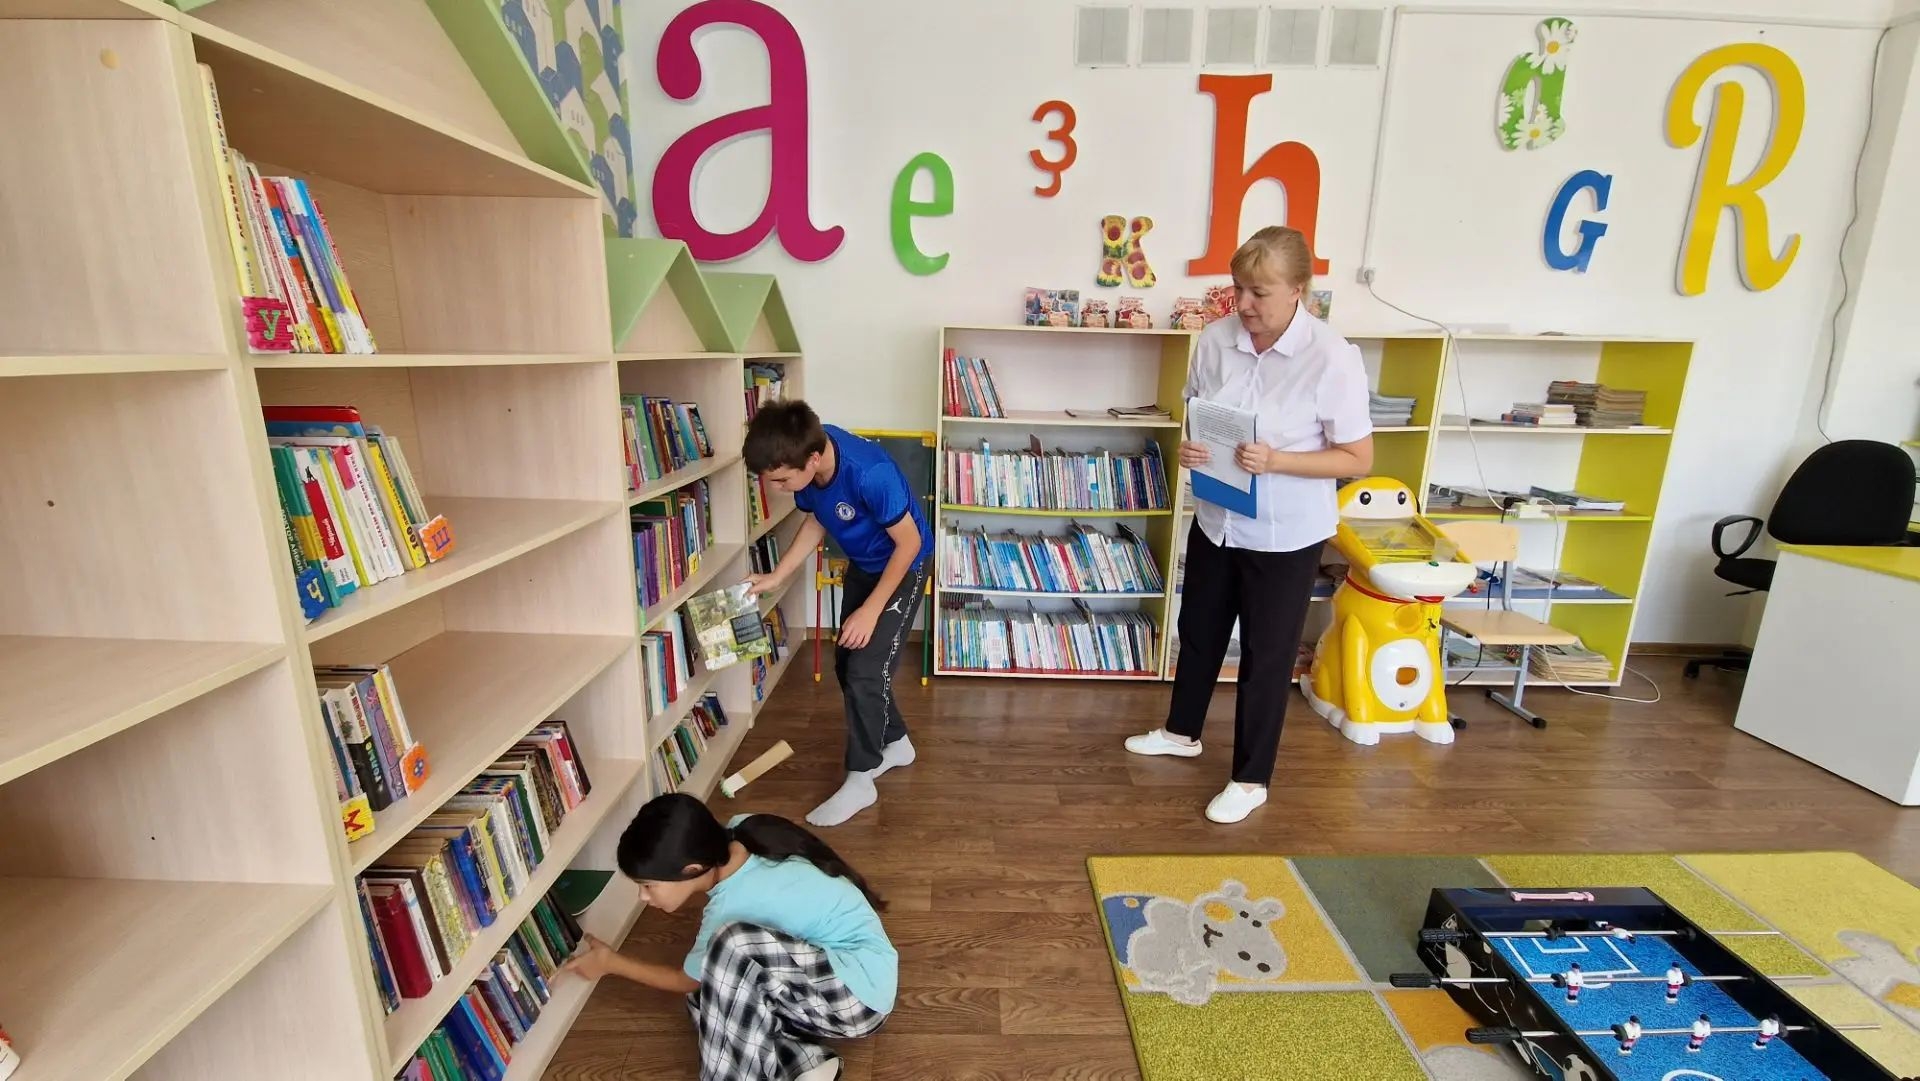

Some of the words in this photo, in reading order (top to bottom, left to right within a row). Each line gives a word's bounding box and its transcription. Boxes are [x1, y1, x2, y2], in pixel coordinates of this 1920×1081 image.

[1667, 42, 1805, 295] R
[1543, 170, 1612, 274] G
[404, 525, 419, 550] 100
